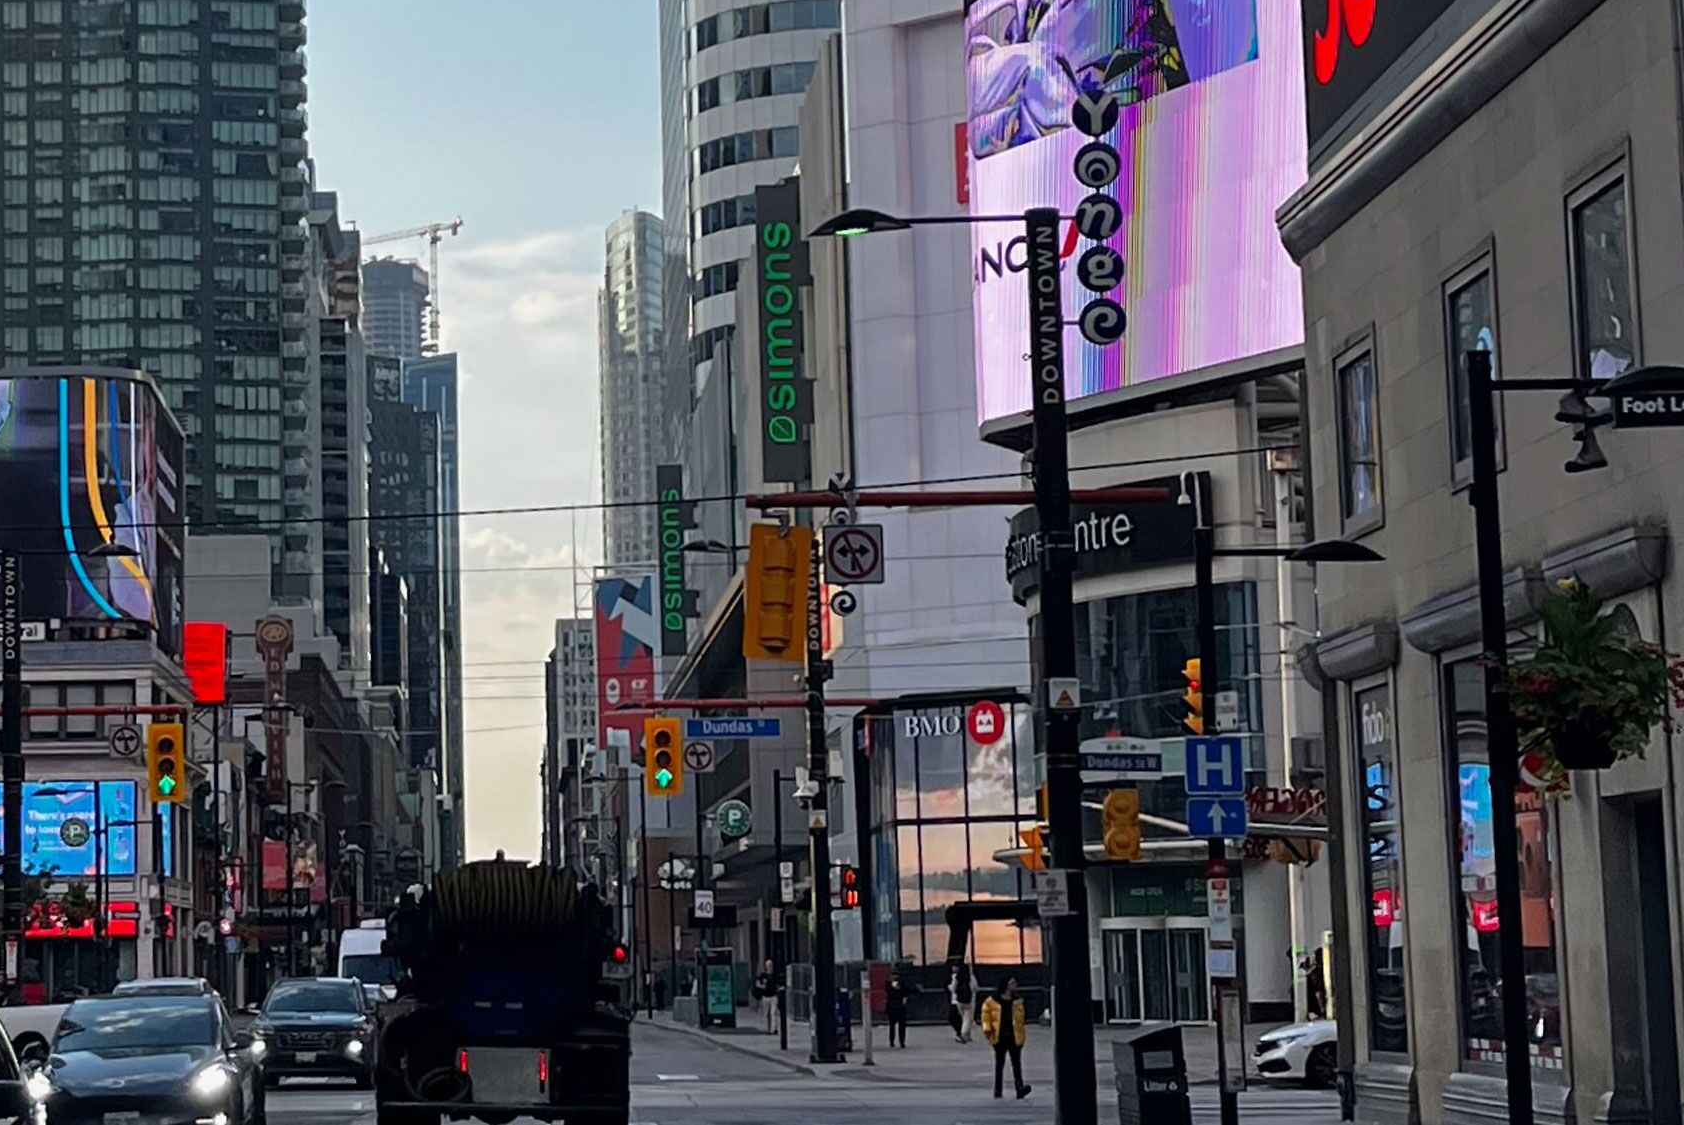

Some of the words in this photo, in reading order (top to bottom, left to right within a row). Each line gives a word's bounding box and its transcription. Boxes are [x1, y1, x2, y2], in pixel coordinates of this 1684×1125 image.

[1035, 226, 1060, 405] DOWNTOWN
[1622, 396, 1666, 414] Foot
[1670, 396, 1684, 414] L
[1074, 511, 1131, 553] ntre
[5, 557, 16, 660] DOWNTOWN
[702, 720, 754, 734] Dundas
[904, 715, 961, 738] BMO
[1196, 744, 1233, 786] H
[697, 901, 713, 914] 40
